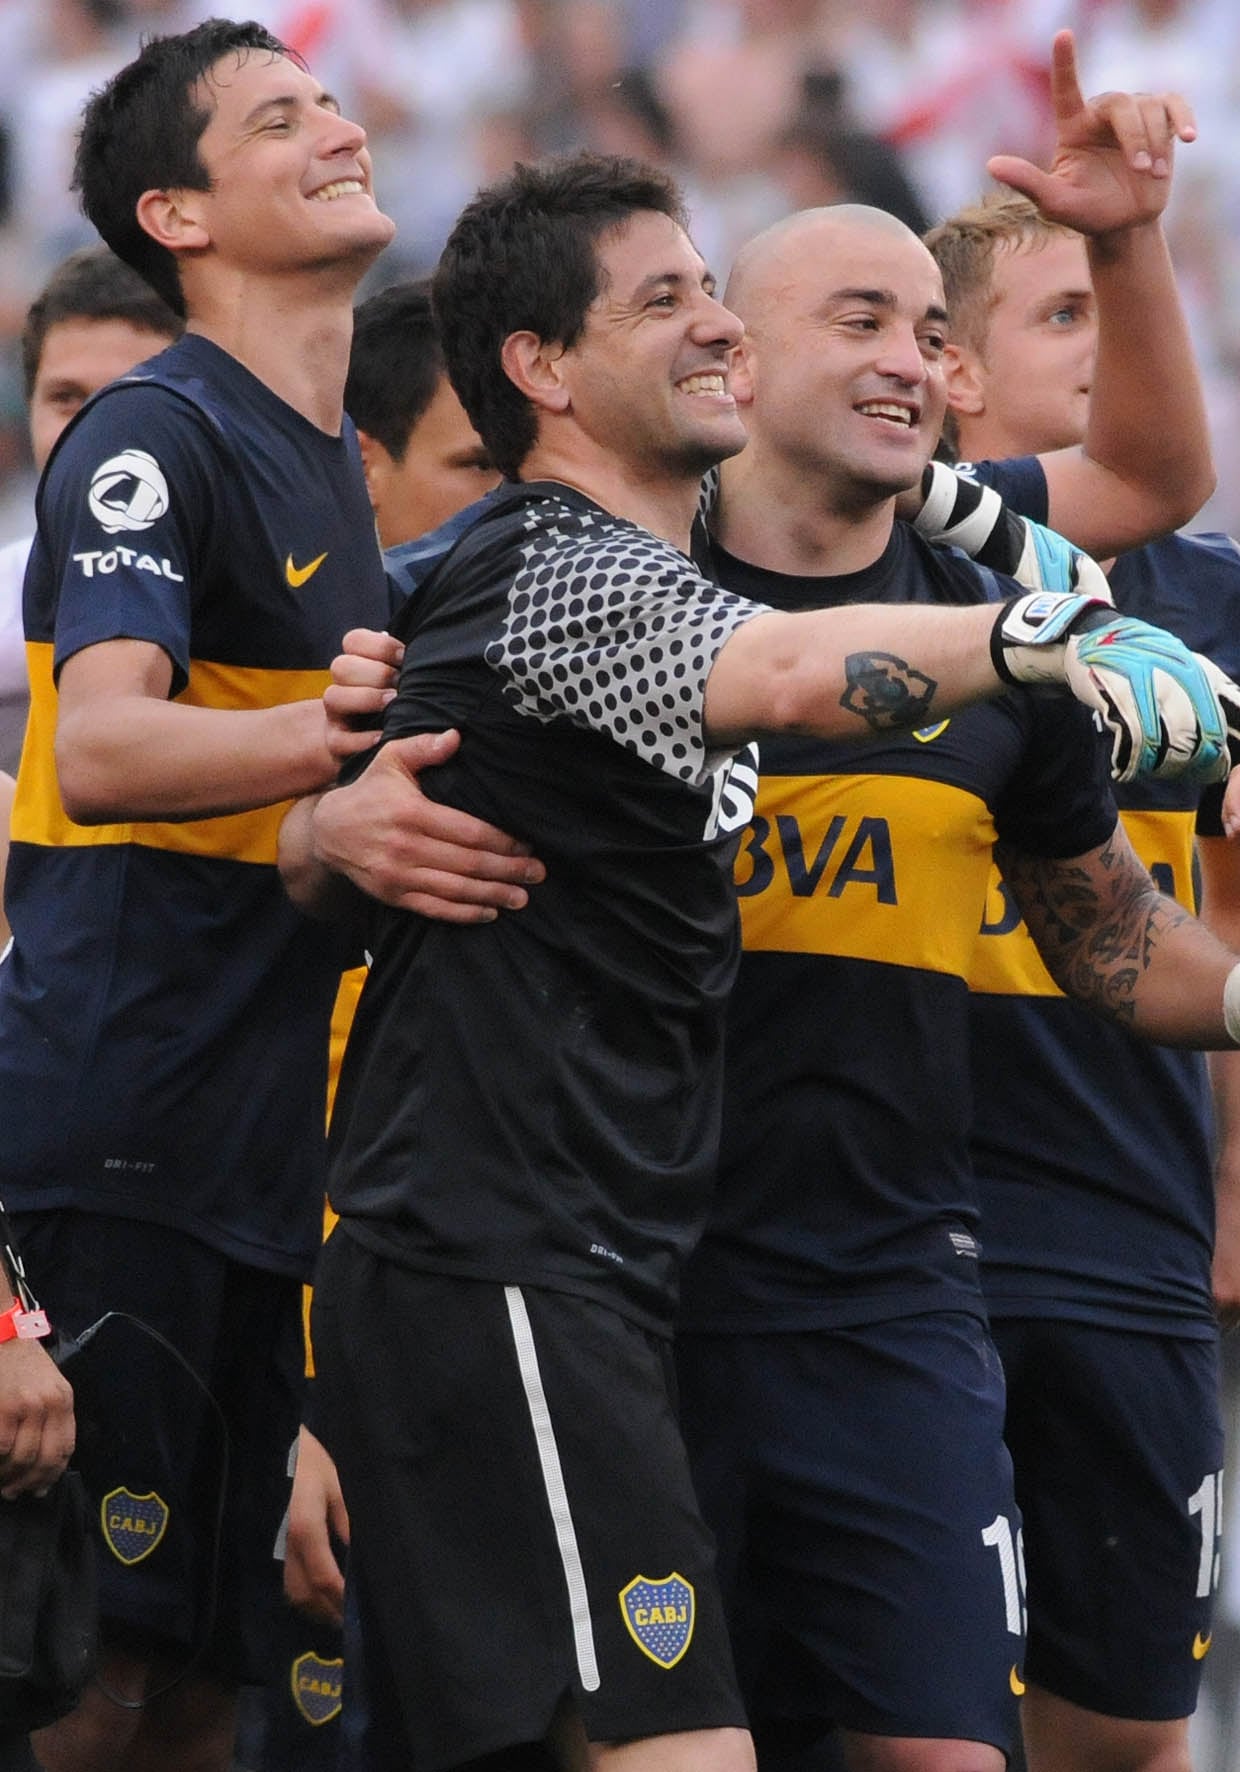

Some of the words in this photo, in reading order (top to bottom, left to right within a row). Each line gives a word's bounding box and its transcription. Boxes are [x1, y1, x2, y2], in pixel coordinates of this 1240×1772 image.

[73, 546, 184, 582] TOTAL
[733, 814, 898, 906] BVA
[104, 1159, 156, 1173] DRI-FIT
[110, 1515, 156, 1535] CABJ
[634, 1605, 688, 1626] CABJ
